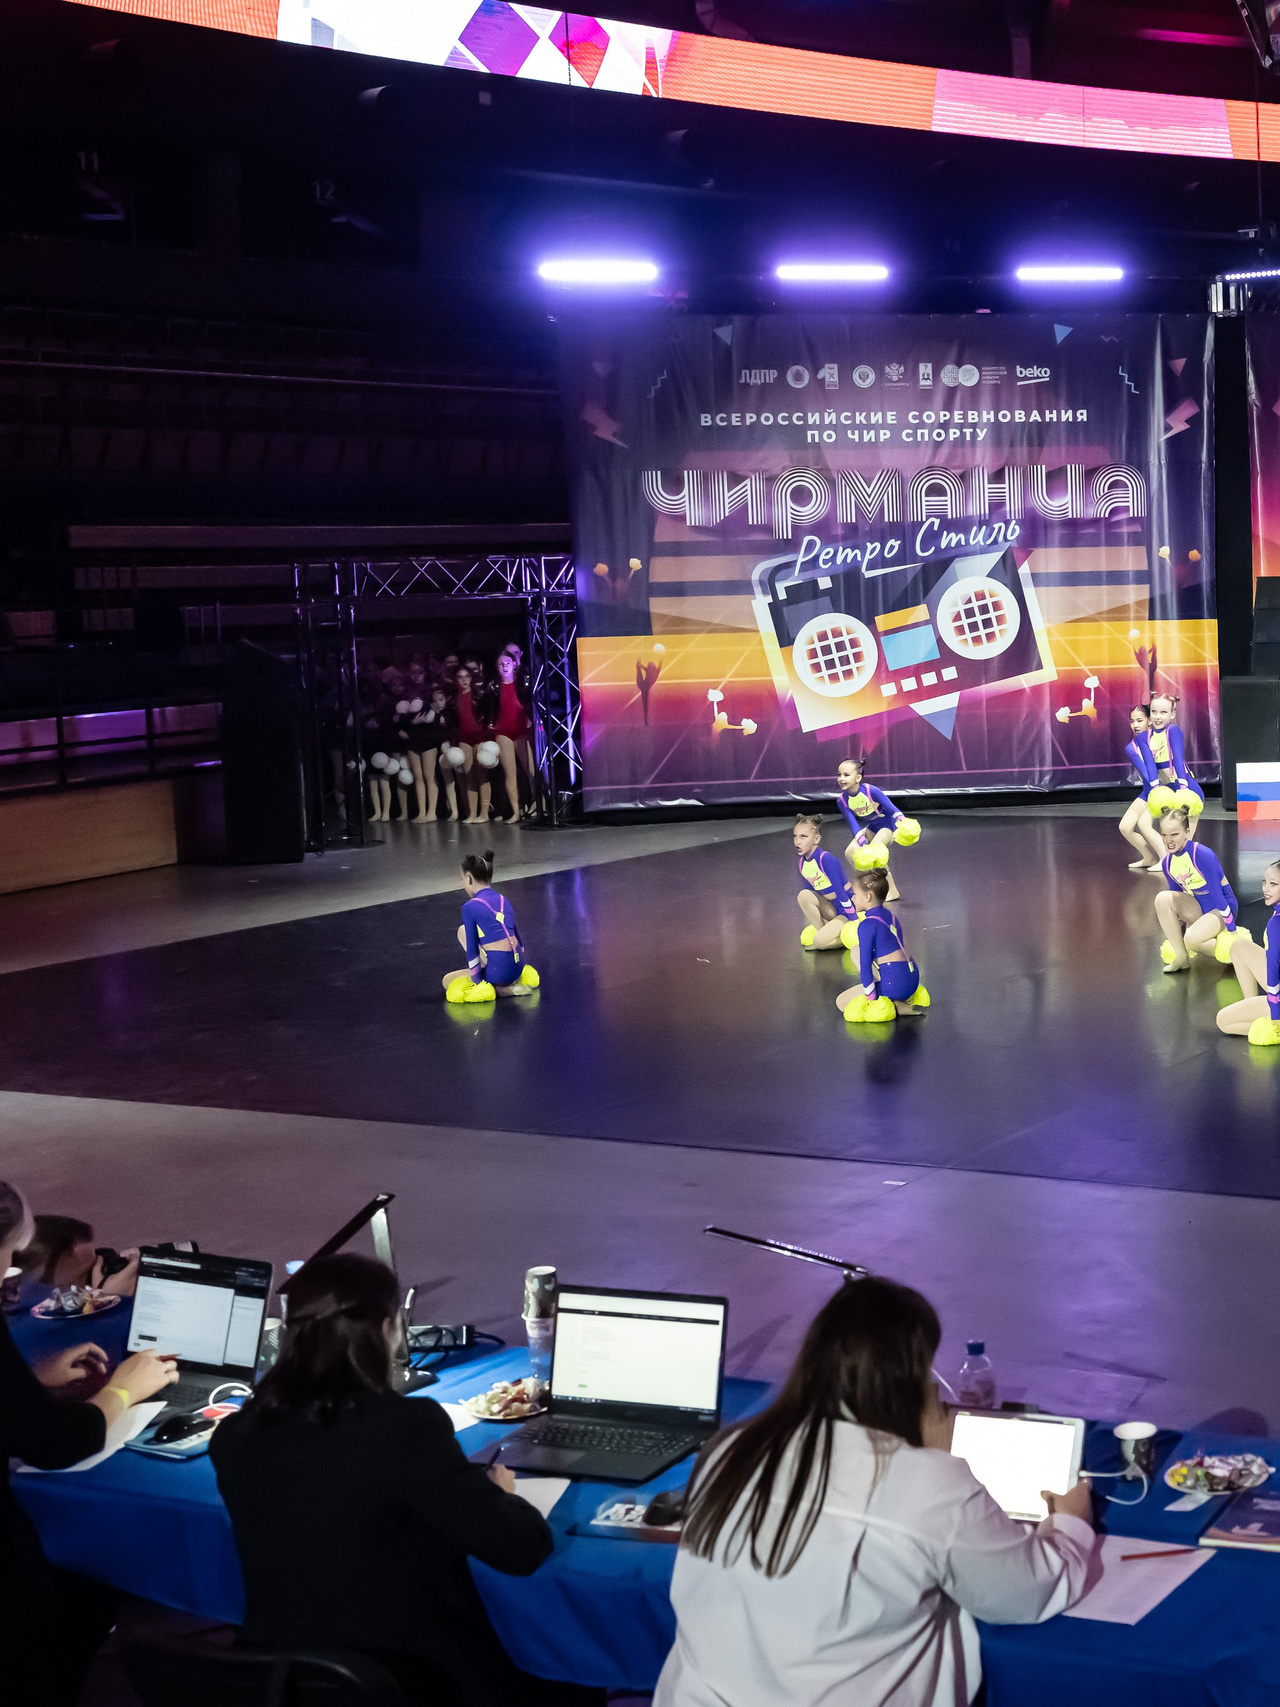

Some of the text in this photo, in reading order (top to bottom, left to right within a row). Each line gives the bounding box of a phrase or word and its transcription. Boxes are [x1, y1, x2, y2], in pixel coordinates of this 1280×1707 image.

[739, 369, 777, 385] ЛДПР
[1016, 366, 1050, 378] beko
[701, 409, 1089, 426] ВСЕРОССИЙСКИЕ СОРЕВНОВАНИЯ
[807, 428, 988, 443] ПО ЧИР СПОРТУ
[794, 517, 1021, 577] Ретро Стиль
